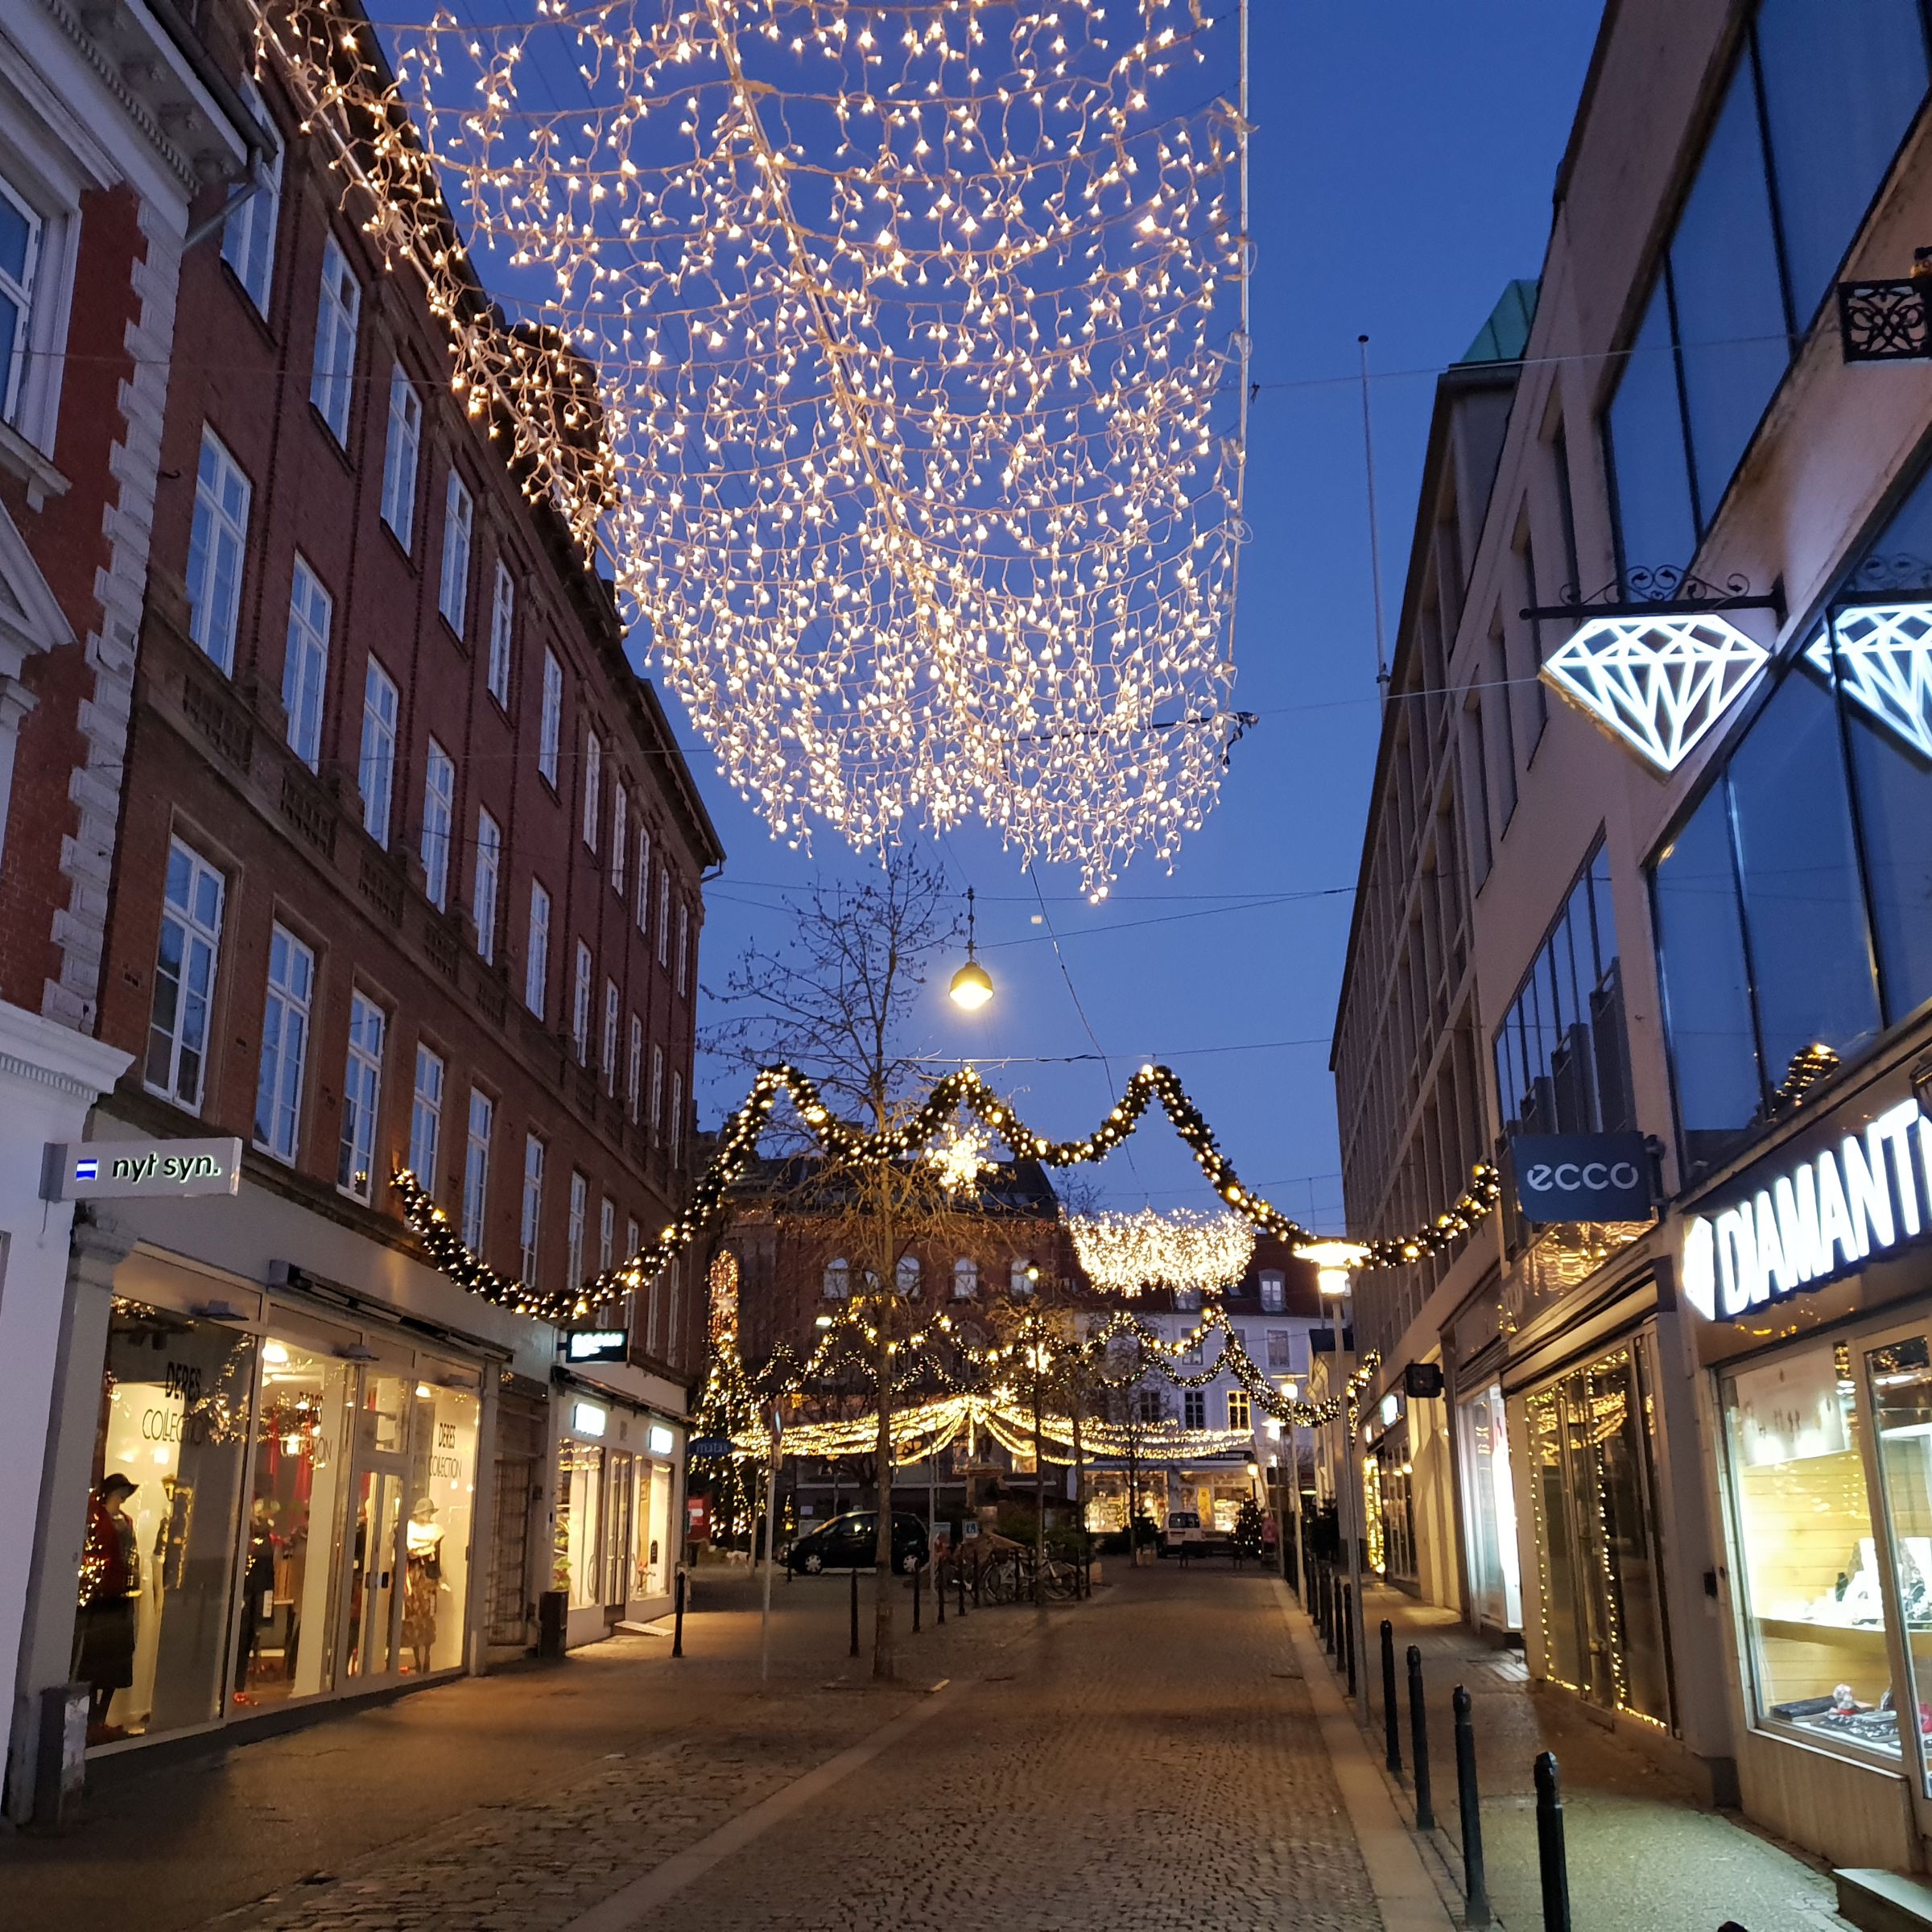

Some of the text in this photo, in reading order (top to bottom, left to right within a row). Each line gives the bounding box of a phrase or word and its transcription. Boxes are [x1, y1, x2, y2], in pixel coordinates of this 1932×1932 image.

[112, 1152, 221, 1184] nyt syn.
[1527, 1162, 1639, 1191] ecco
[165, 1360, 201, 1403] DERES
[438, 1422, 456, 1449] DERES
